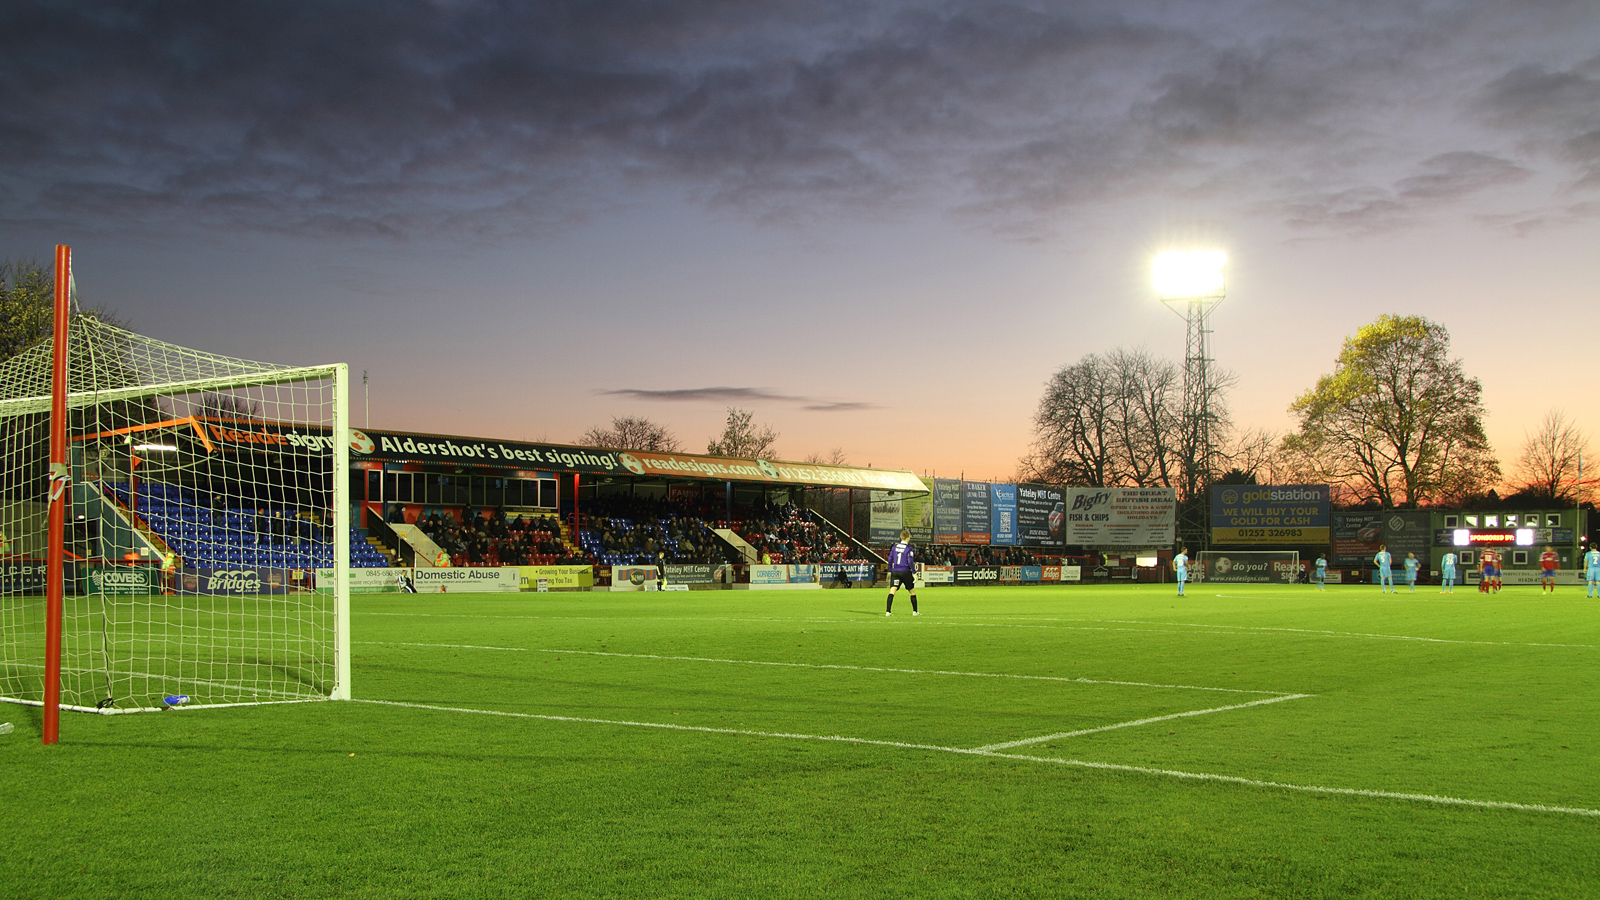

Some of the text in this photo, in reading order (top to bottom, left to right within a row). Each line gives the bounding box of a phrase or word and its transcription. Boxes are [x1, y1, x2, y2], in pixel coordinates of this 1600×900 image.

[209, 425, 288, 445] Reade
[381, 436, 619, 470] Aldershot's best signing!
[642, 457, 762, 476] readesigns.com
[779, 467, 820, 481] 01252
[816, 470, 863, 484] 336000
[1020, 488, 1037, 500] Yateley
[1047, 491, 1061, 500] Centre
[1242, 489, 1320, 504] goldstation
[1071, 492, 1112, 511] BigFry
[1223, 507, 1319, 516] WE WILL BUY YOUR
[1230, 517, 1310, 525] GOLD FOR CASH
[1238, 529, 1303, 537] 01252 326983
[897, 553, 902, 564] 1
[1446, 557, 1454, 565] 26
[1593, 557, 1598, 565] 2
[664, 565, 683, 575] Yateley
[694, 565, 710, 573] Centre
[858, 565, 869, 573] HRE
[1187, 562, 1205, 571] ade
[1232, 562, 1268, 573] do you?
[1274, 562, 1306, 572] Reade
[105, 572, 147, 583] COVERS
[416, 569, 500, 580] Domestic Abuse
[757, 570, 782, 578] CORNBERRY
[973, 568, 997, 580] adidas
[1043, 571, 1060, 580] Bridges
[1187, 572, 1205, 582] gns
[1281, 572, 1298, 582] sig
[207, 575, 261, 593] Bridges
